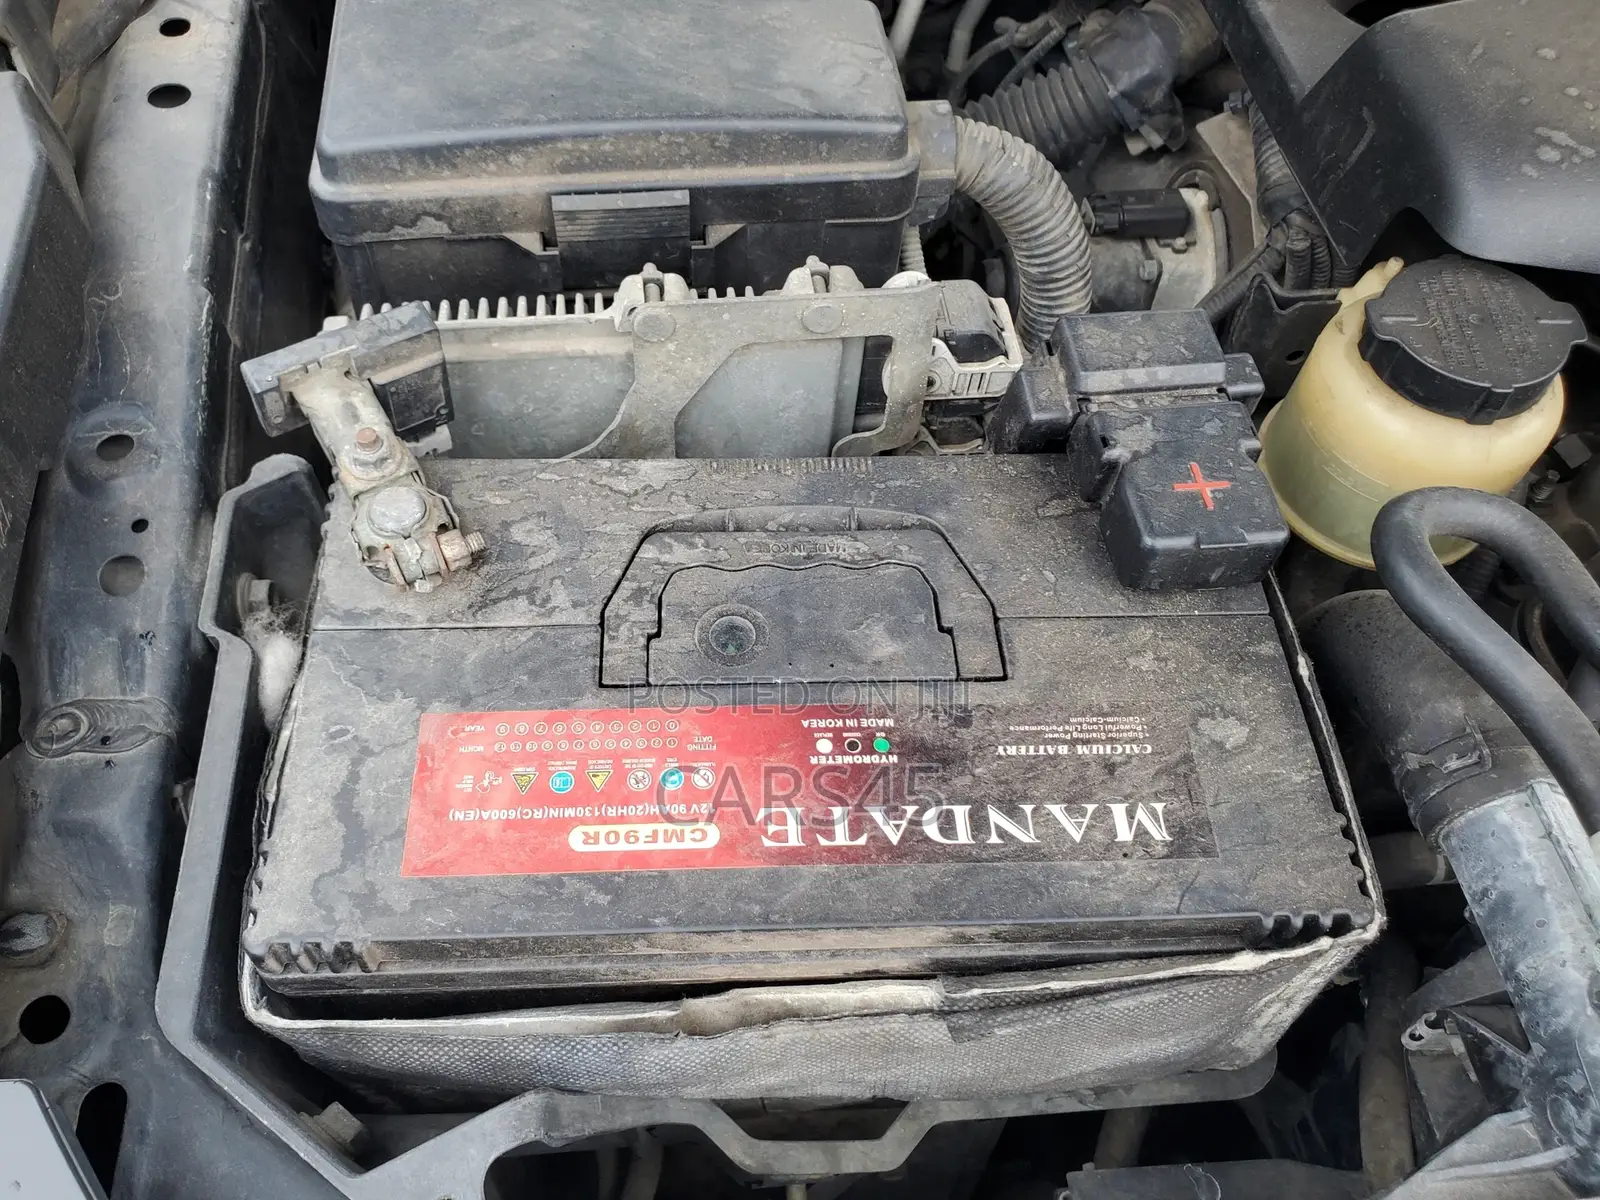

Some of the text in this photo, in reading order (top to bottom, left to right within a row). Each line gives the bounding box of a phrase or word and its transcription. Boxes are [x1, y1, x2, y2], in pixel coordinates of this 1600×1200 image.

[801, 718, 894, 728] MADE IN KOREA
[996, 744, 1152, 756] CALCIUM BATTERY
[810, 755, 898, 764] HYDROMETER
[690, 802, 715, 815] 12V
[754, 802, 1173, 848] MANDATE
[580, 828, 709, 846] CMF90R
